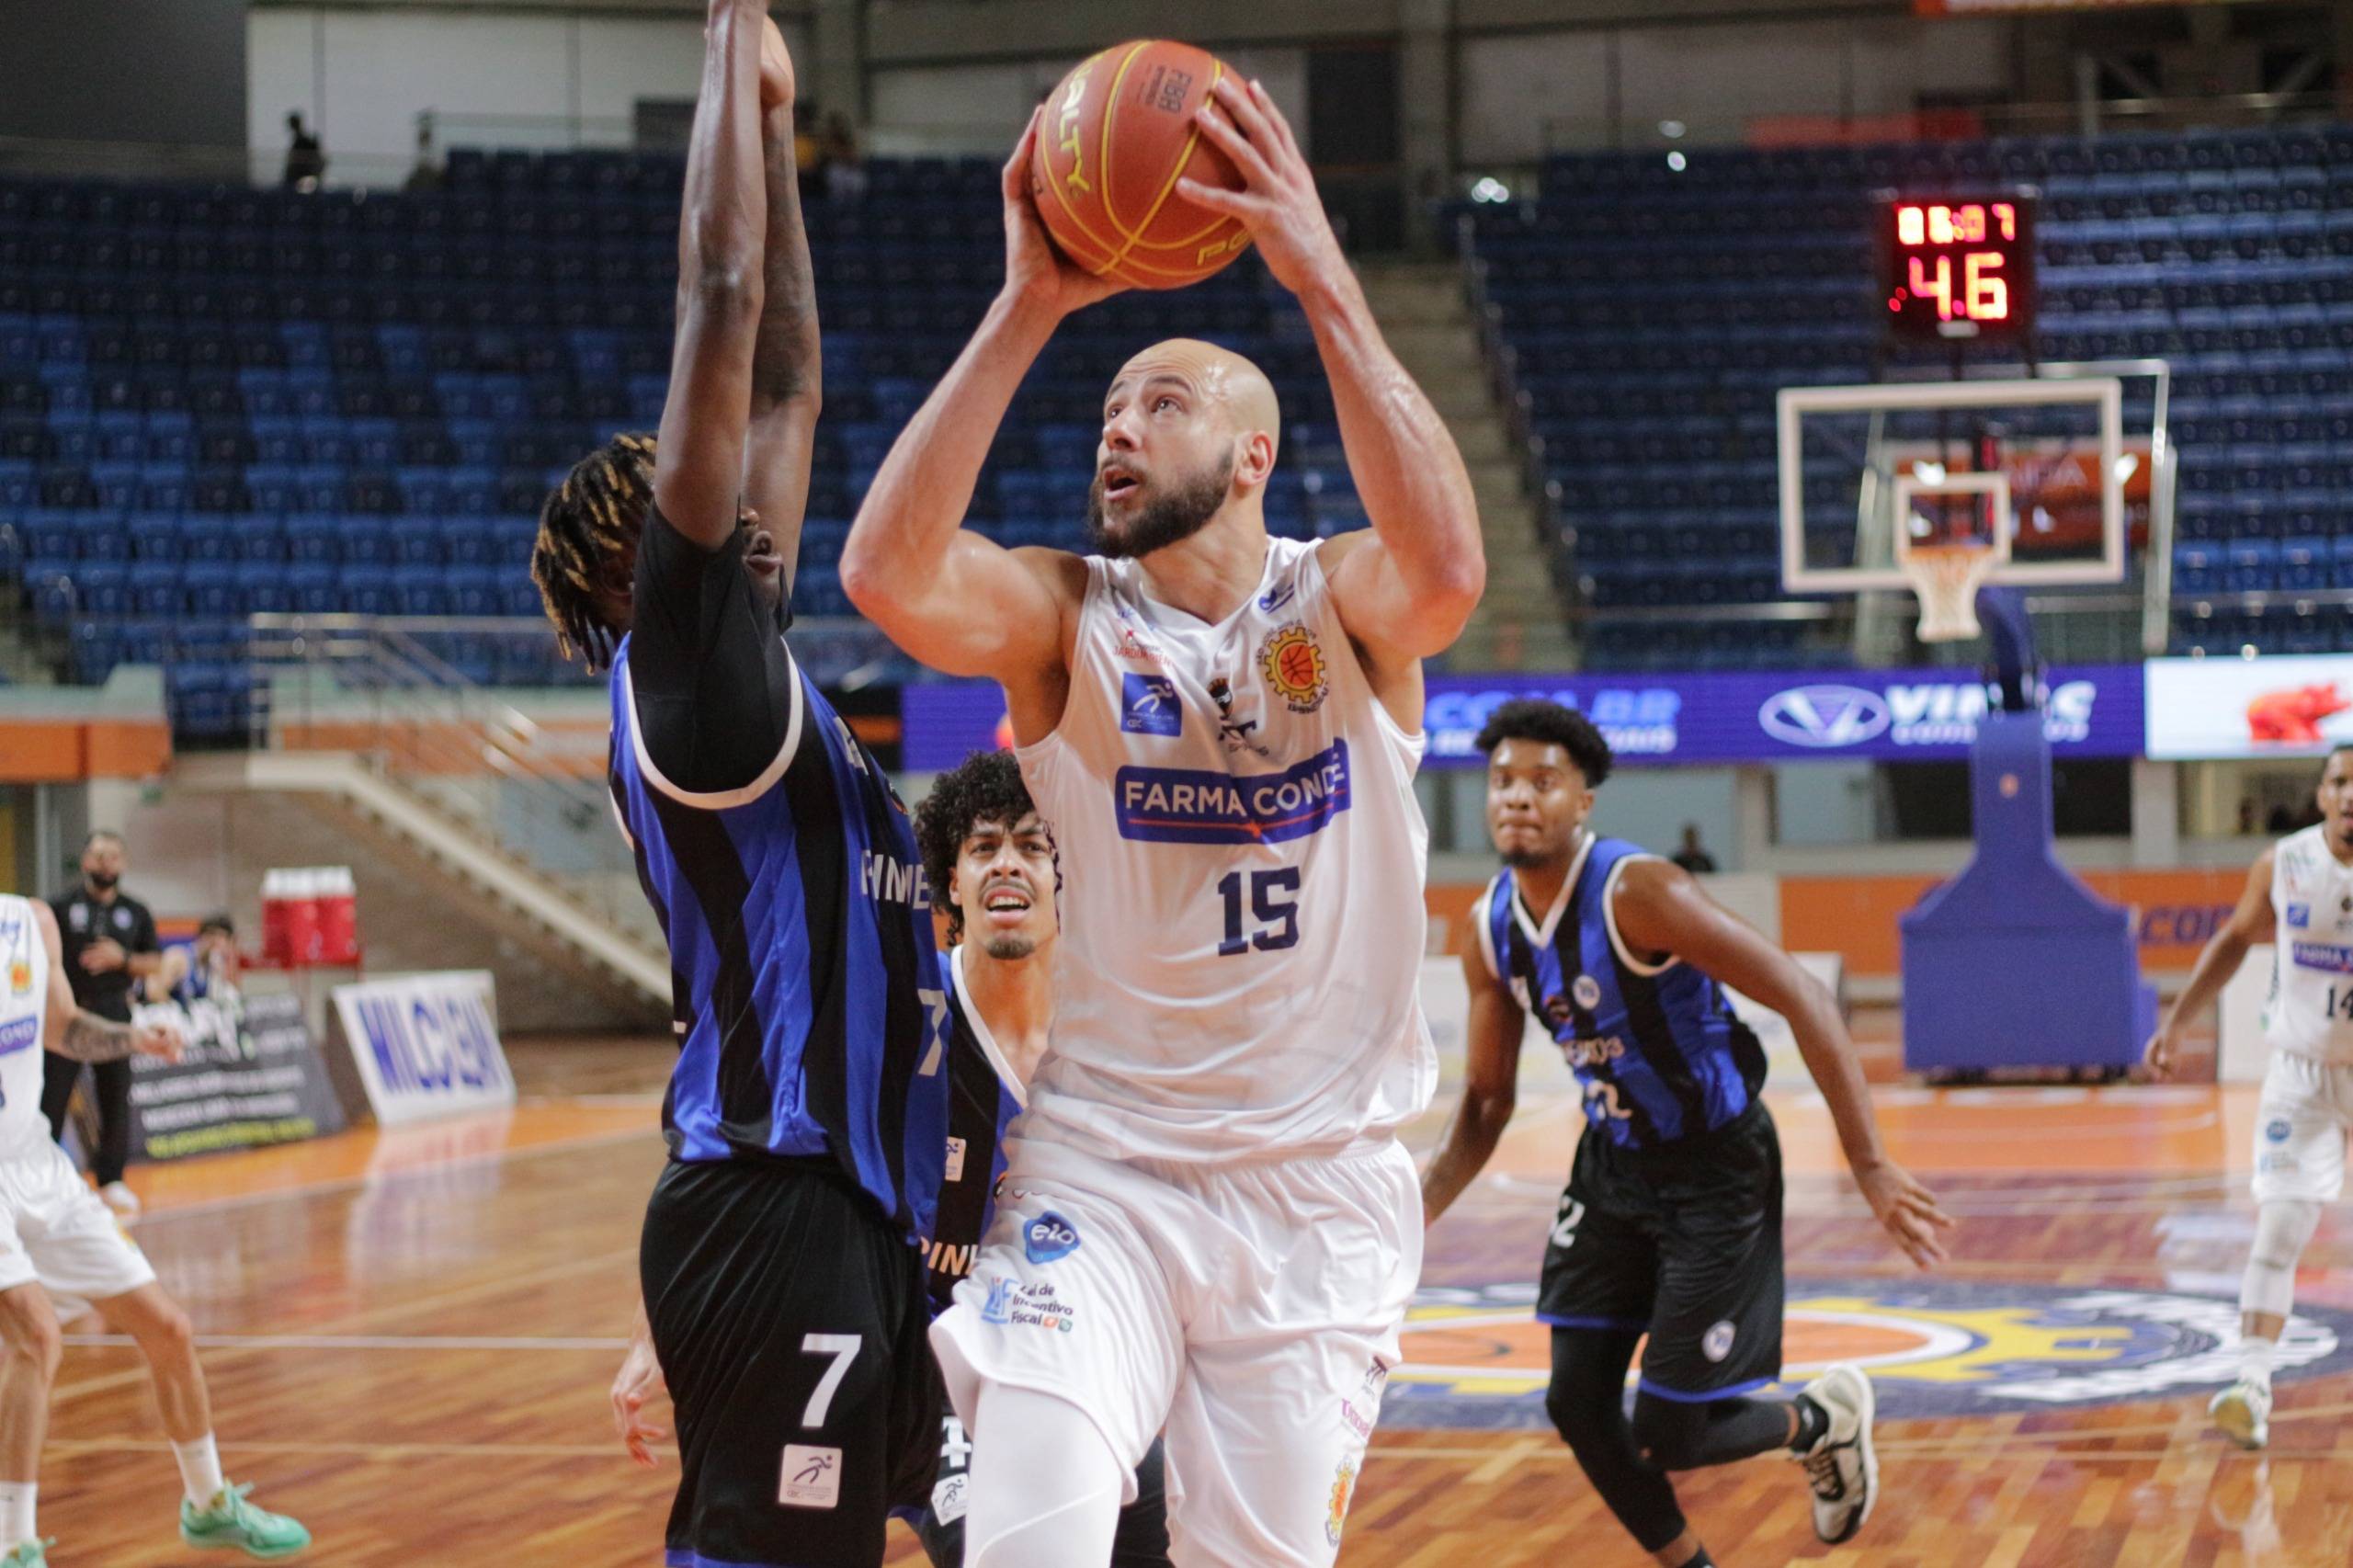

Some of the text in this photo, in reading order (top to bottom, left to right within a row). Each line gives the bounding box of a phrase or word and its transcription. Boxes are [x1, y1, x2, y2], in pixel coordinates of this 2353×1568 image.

[1125, 780, 1247, 817] FARMA
[1217, 865, 1302, 958] 15
[918, 988, 948, 1076] 7
[1030, 1223, 1076, 1245] elo
[1039, 1283, 1055, 1297] de
[1011, 1310, 1043, 1326] Fiscal
[801, 1333, 862, 1427] 7
